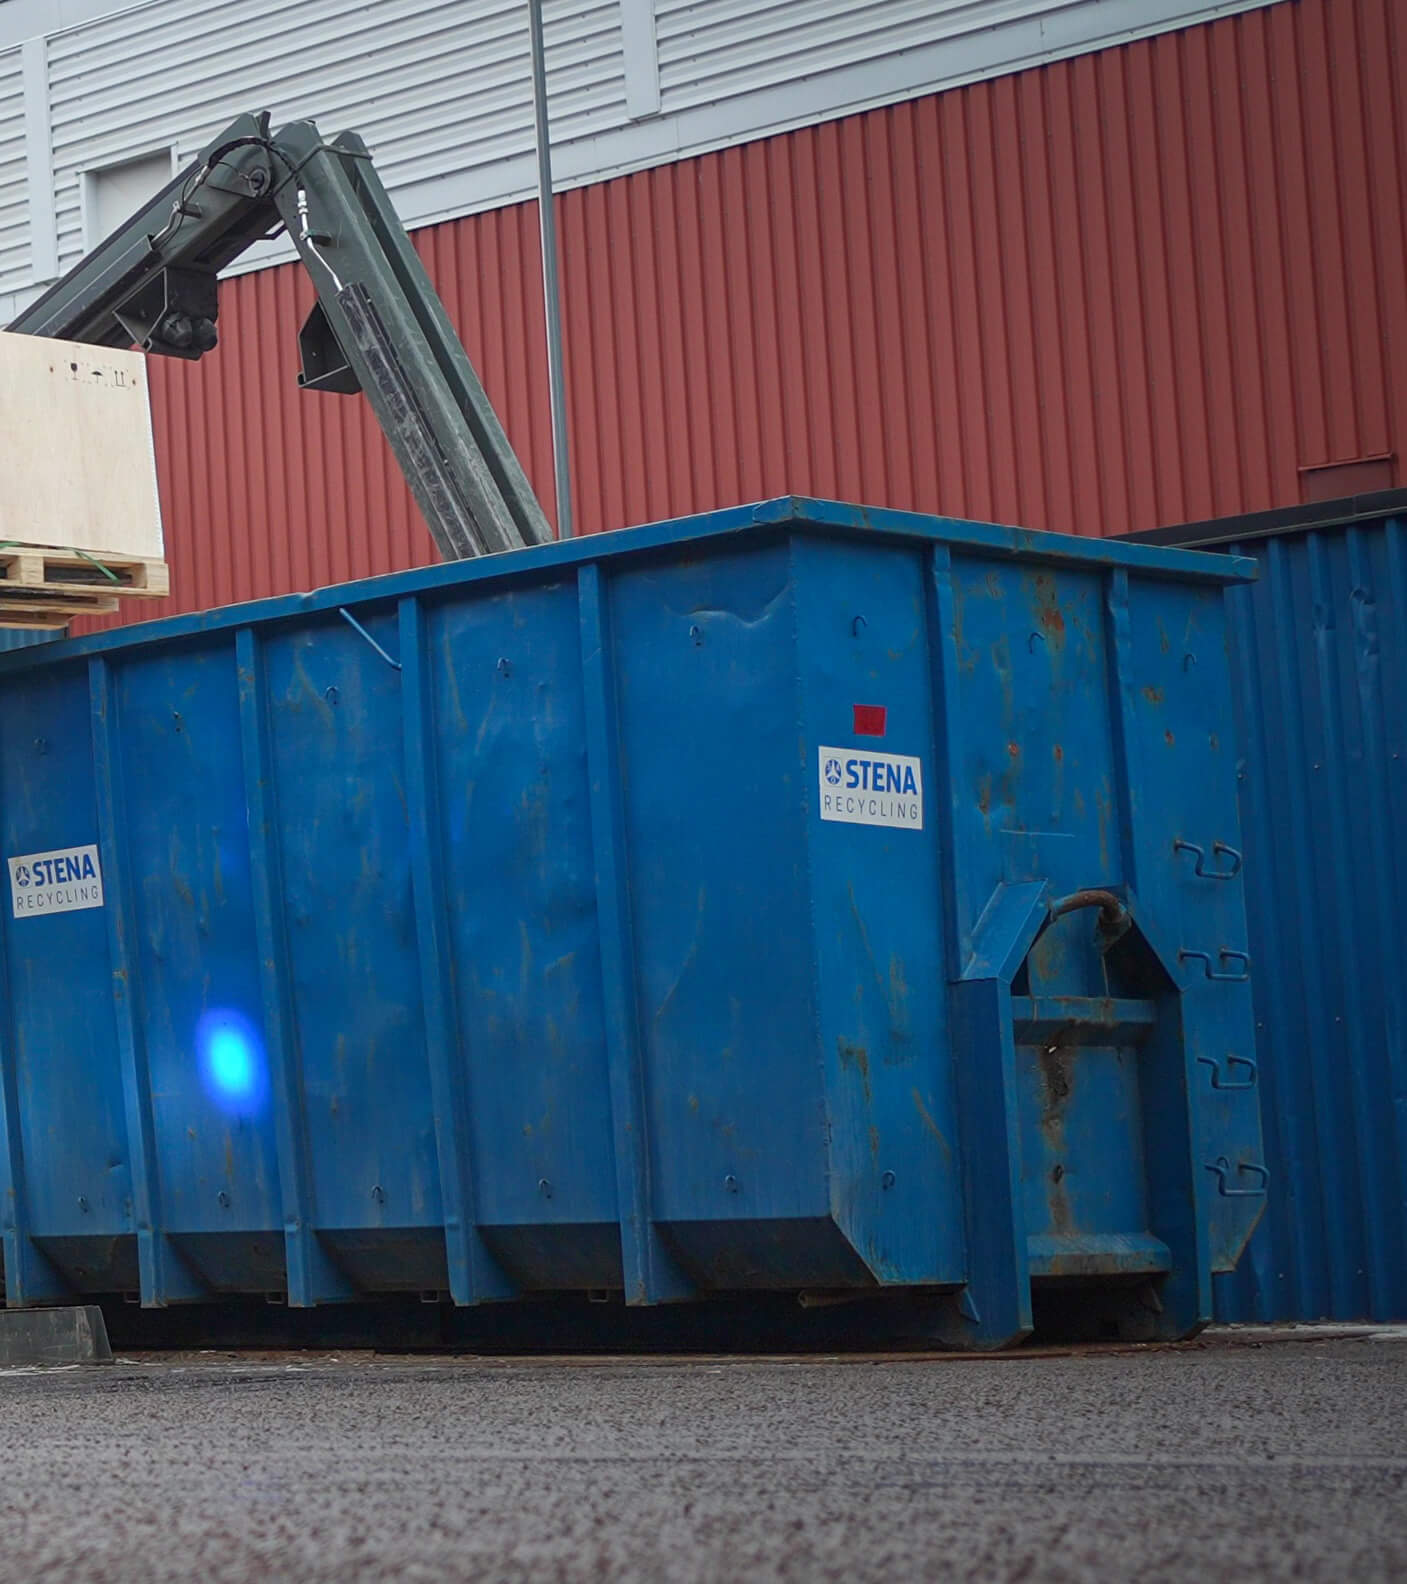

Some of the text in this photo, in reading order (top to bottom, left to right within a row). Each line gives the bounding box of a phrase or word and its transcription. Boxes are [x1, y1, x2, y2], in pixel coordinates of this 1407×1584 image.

[845, 759, 918, 795] STENA
[824, 795, 918, 820] RECYCLING
[32, 854, 96, 886] STENA
[17, 886, 99, 910] RECYCLING
